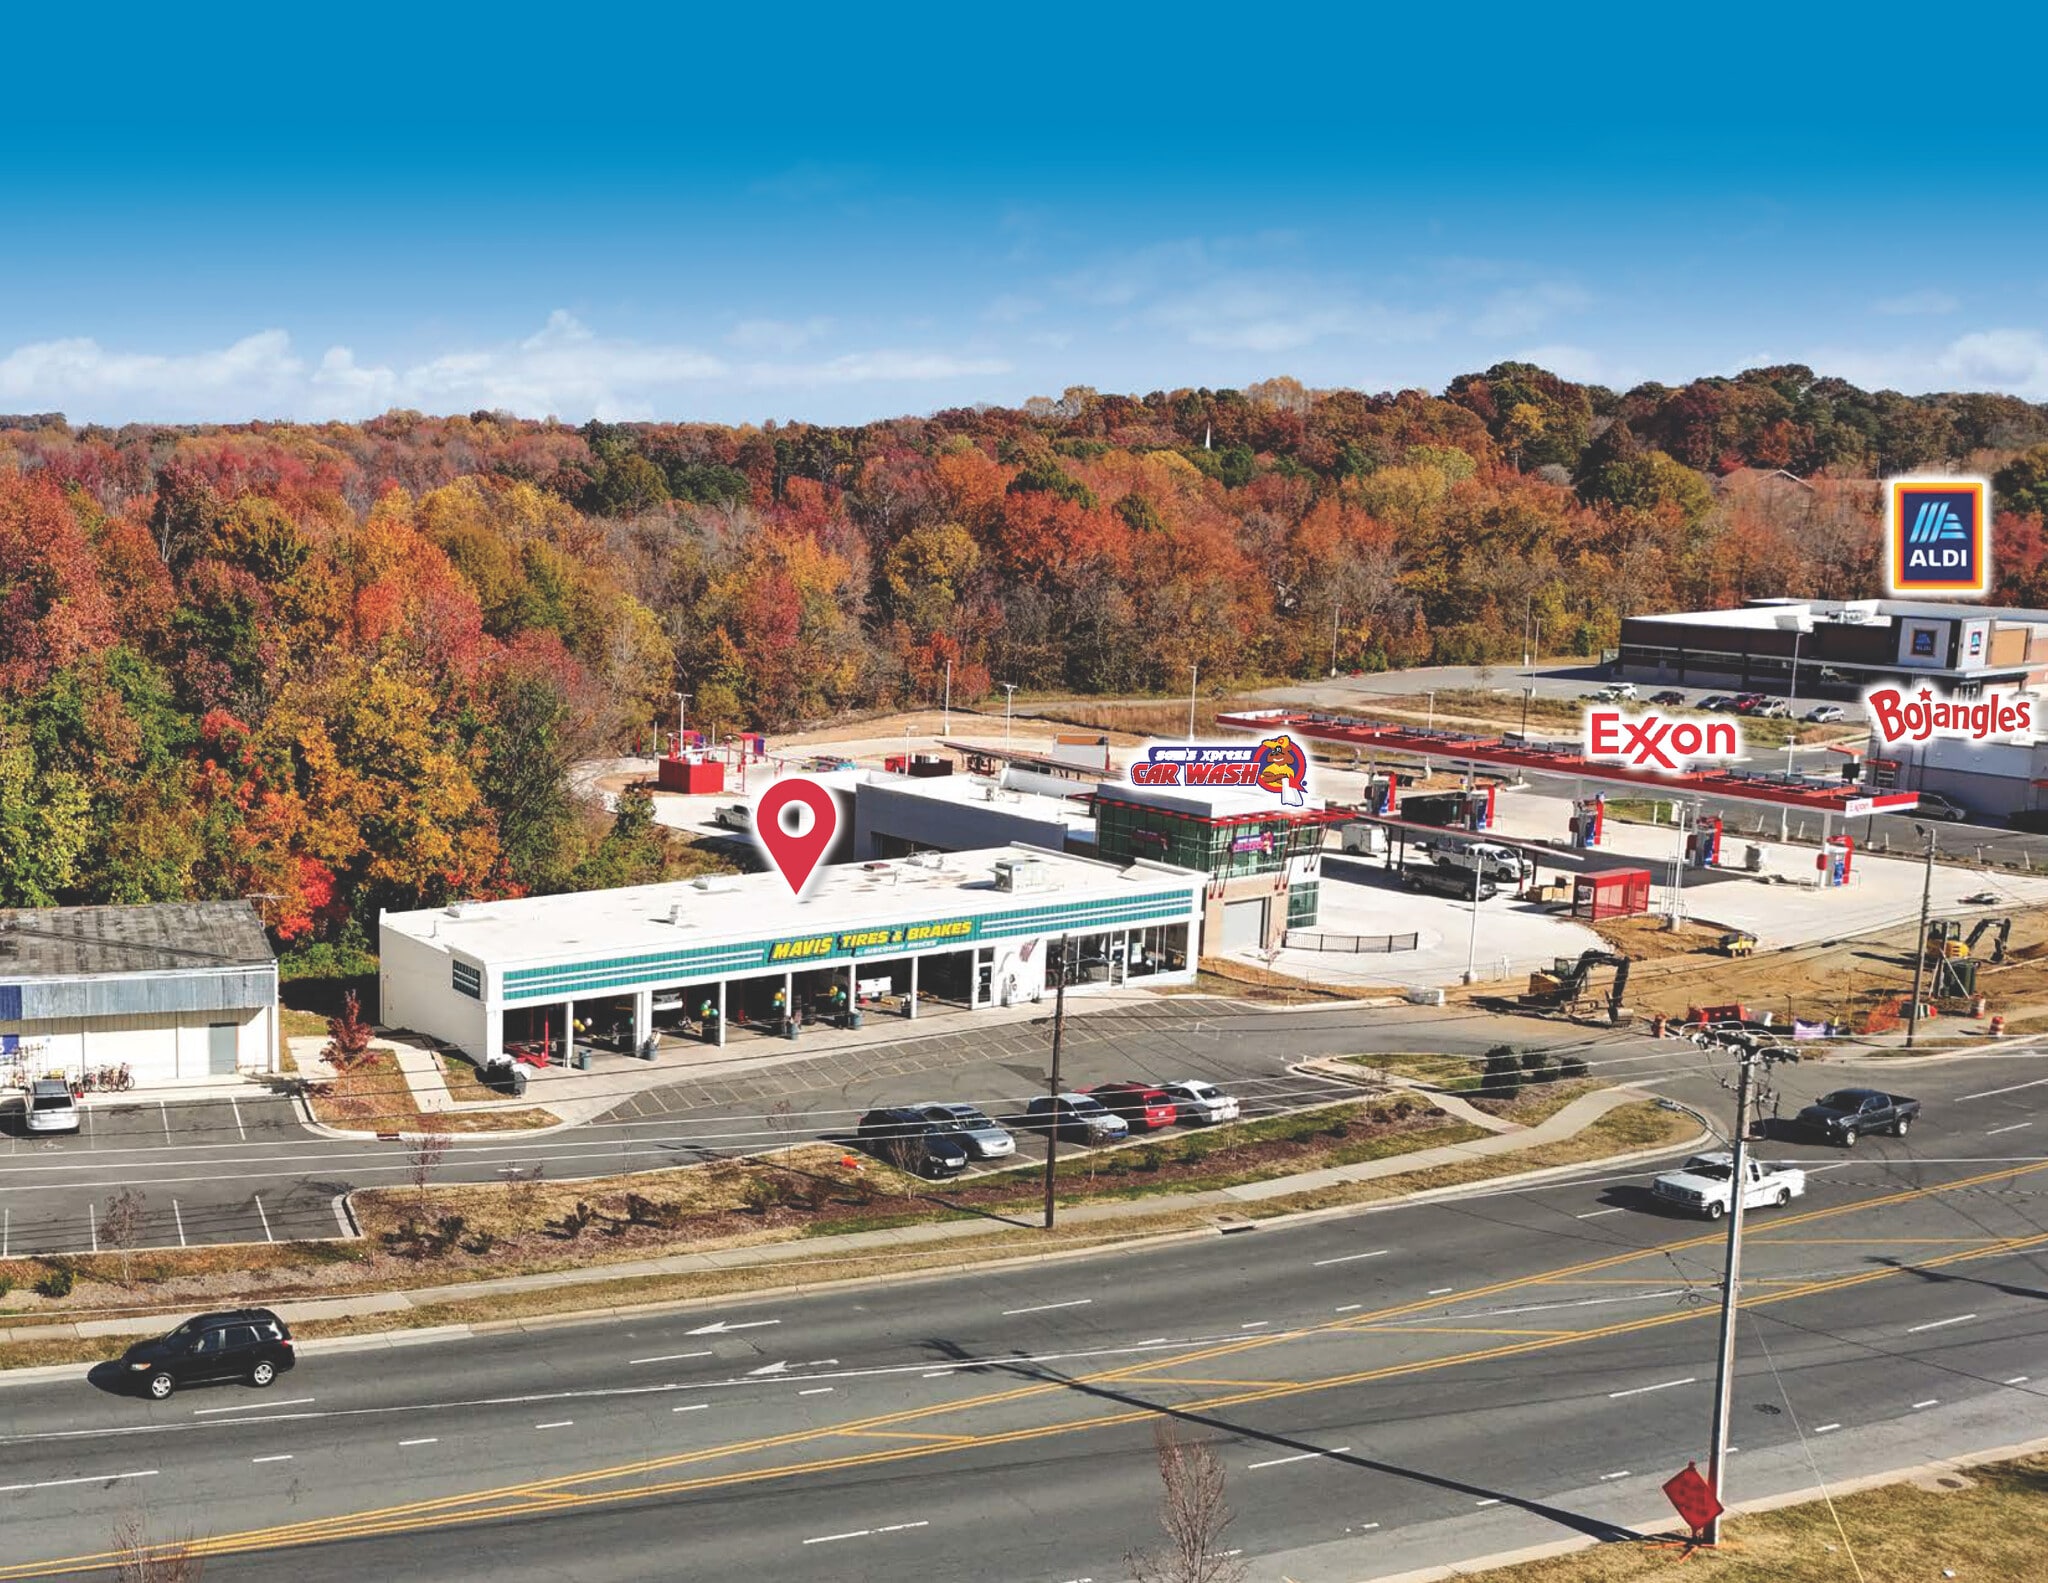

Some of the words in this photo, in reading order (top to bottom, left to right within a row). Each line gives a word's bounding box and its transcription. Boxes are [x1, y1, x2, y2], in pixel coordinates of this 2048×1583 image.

[772, 936, 833, 959] MAVIS
[842, 930, 889, 948] TIRES
[892, 930, 903, 941] &
[906, 921, 972, 940] BRAKES
